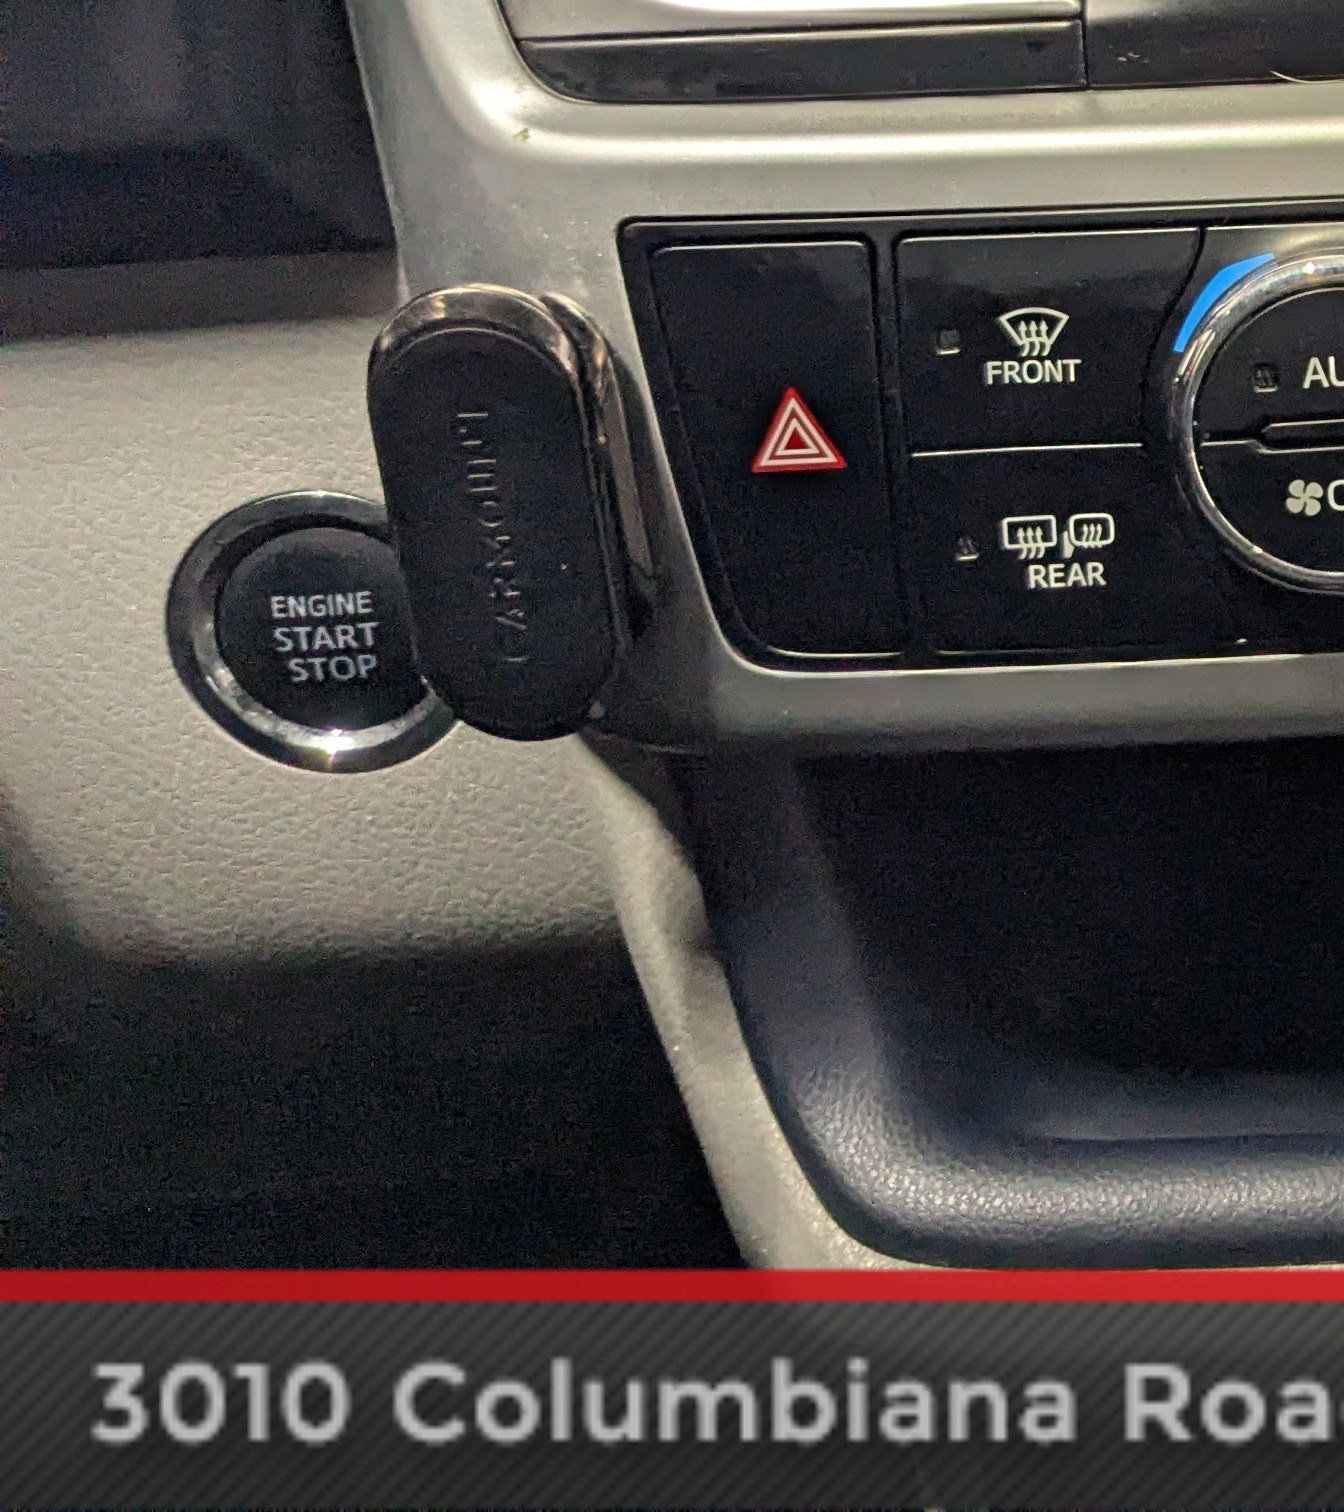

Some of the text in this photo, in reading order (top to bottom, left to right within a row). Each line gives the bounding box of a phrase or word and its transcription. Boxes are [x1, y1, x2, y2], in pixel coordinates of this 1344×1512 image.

[986, 358, 1082, 386] FRONT
[1028, 561, 1107, 589] REAR
[270, 590, 374, 619] ENGINE
[272, 621, 380, 654] START
[287, 652, 378, 684] STOP
